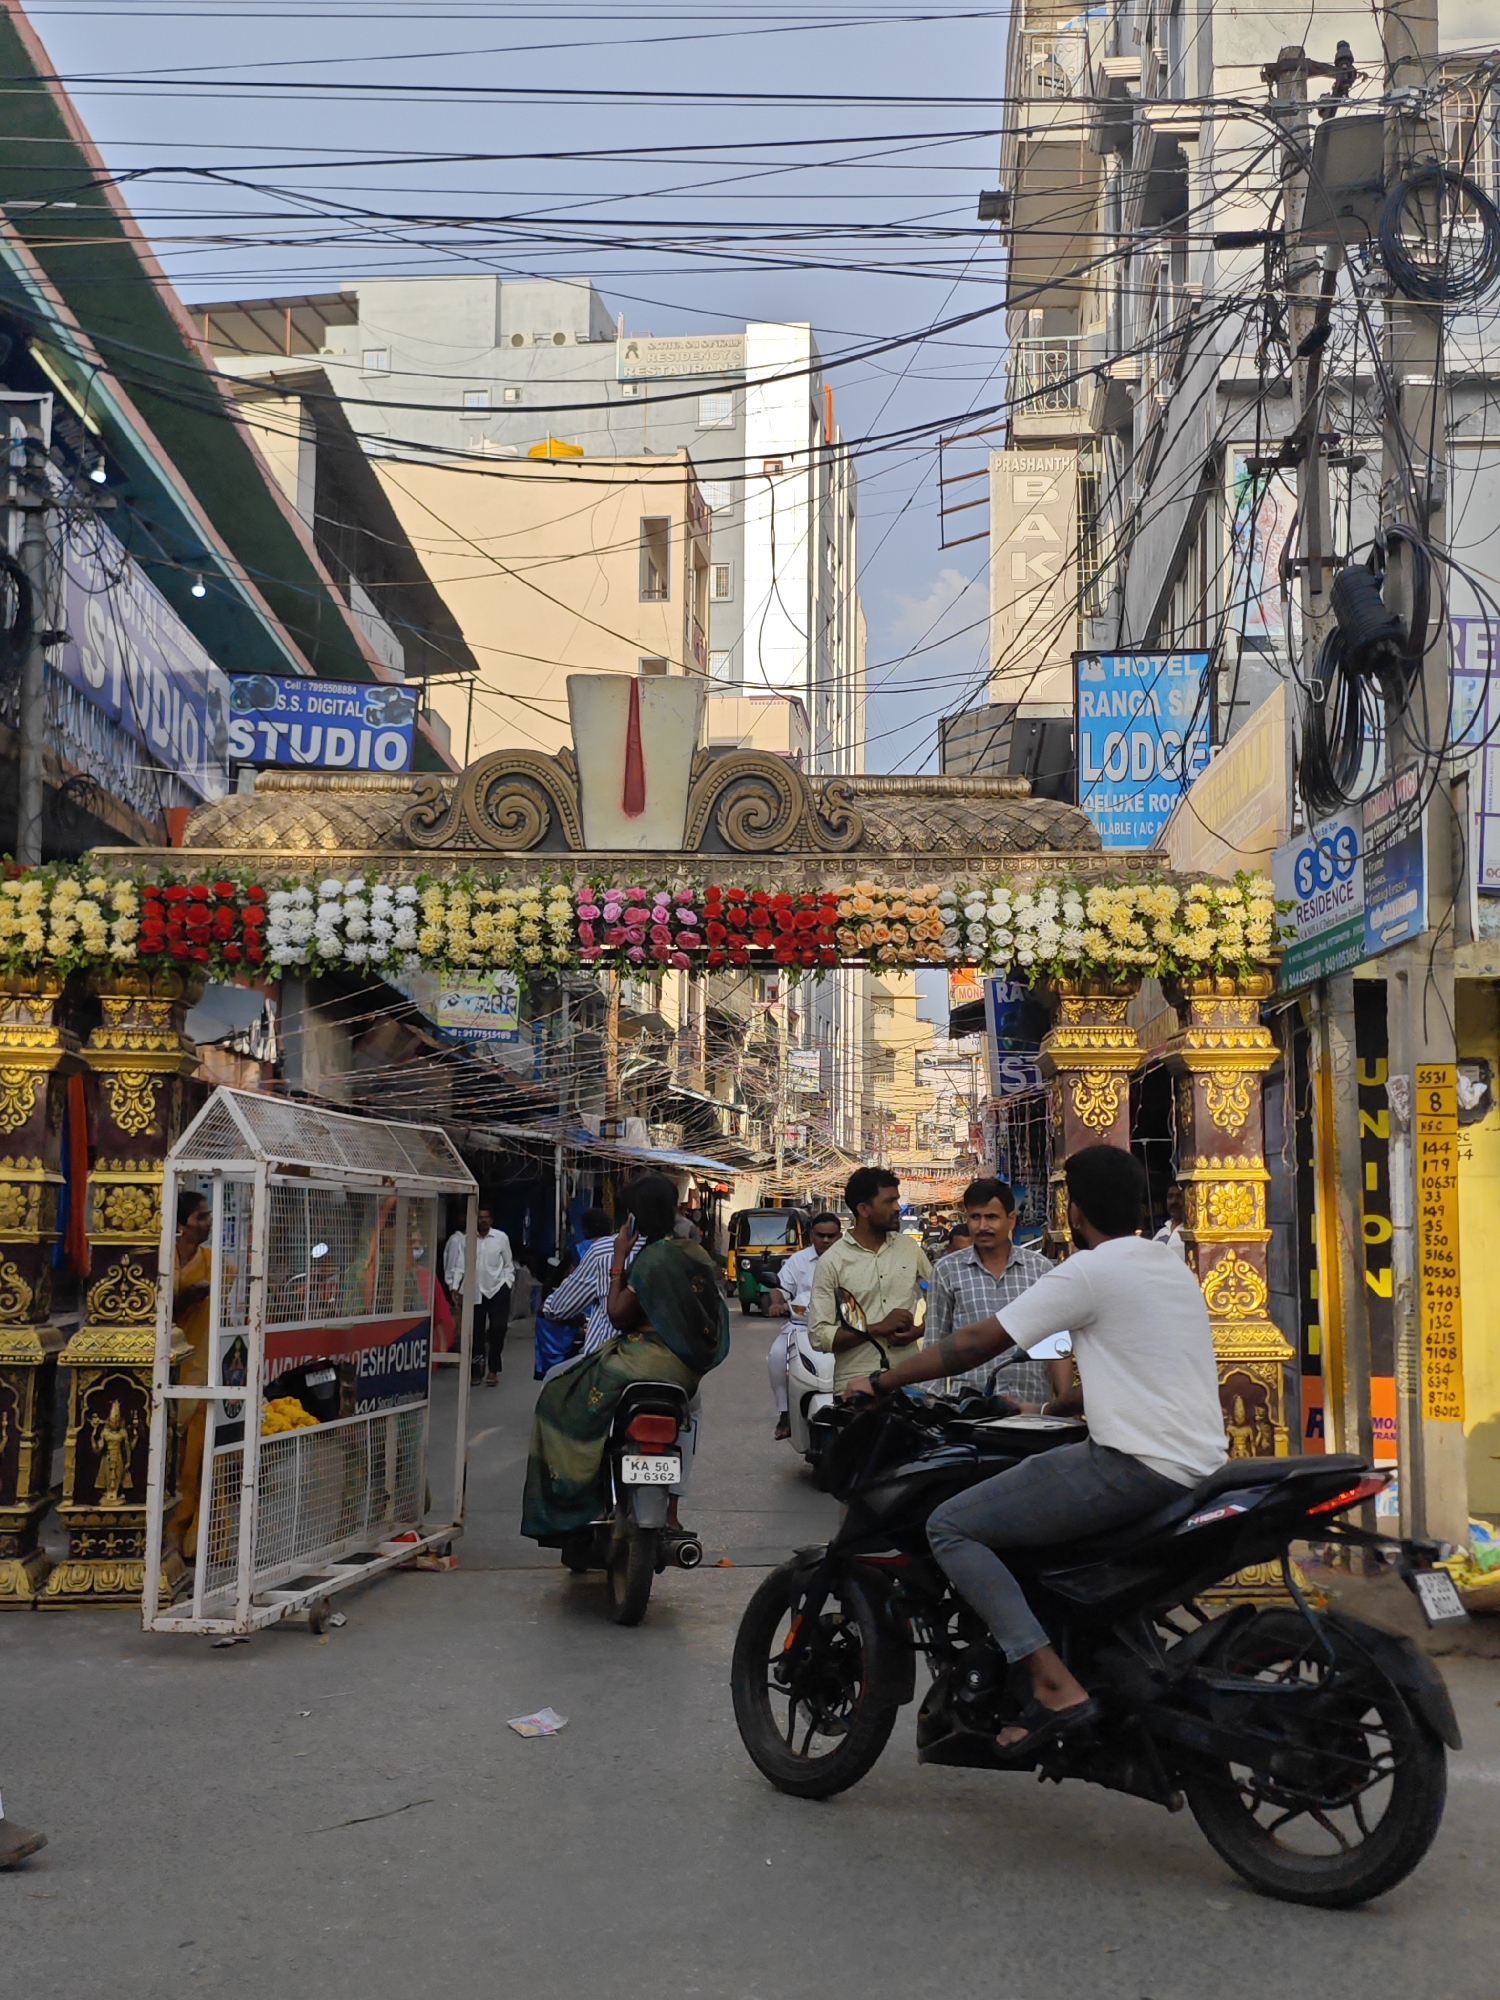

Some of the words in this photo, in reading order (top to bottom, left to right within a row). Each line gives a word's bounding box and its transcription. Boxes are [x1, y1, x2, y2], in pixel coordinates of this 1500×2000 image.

[647, 350, 731, 362] RESIDENCY
[623, 362, 740, 377] RESTAURANT
[994, 457, 1075, 472] PRASHANTHI
[1113, 655, 1199, 677] HOTEL
[82, 597, 198, 773] STUDIO
[307, 697, 364, 718] DIGITAL
[1080, 690, 1161, 717] RANGA
[229, 718, 408, 771] STUDIO
[1082, 729, 1207, 782] LODGE
[1082, 794, 1144, 813] DELUXE
[1296, 880, 1354, 926] RESIDENCE
[1430, 1092, 1442, 1112] 8
[1423, 1142, 1452, 1155] 144
[1423, 1158, 1449, 1173] 179
[1422, 1176, 1457, 1189] 10637
[1425, 1190, 1441, 1202] 33
[1425, 1250, 1453, 1262] 5166
[1426, 1282, 1460, 1298] 2403
[1428, 1301, 1453, 1314] 970
[1429, 1314, 1452, 1330] 132
[1426, 1332, 1456, 1344] 6215
[387, 1339, 428, 1374] POLICE
[1426, 1346, 1457, 1360] 7108
[1427, 1362, 1454, 1375] 654
[1428, 1376, 1449, 1390] 639
[631, 1461, 650, 1471] KA
[655, 1462, 669, 1472] 50
[644, 1472, 675, 1482] 6362
